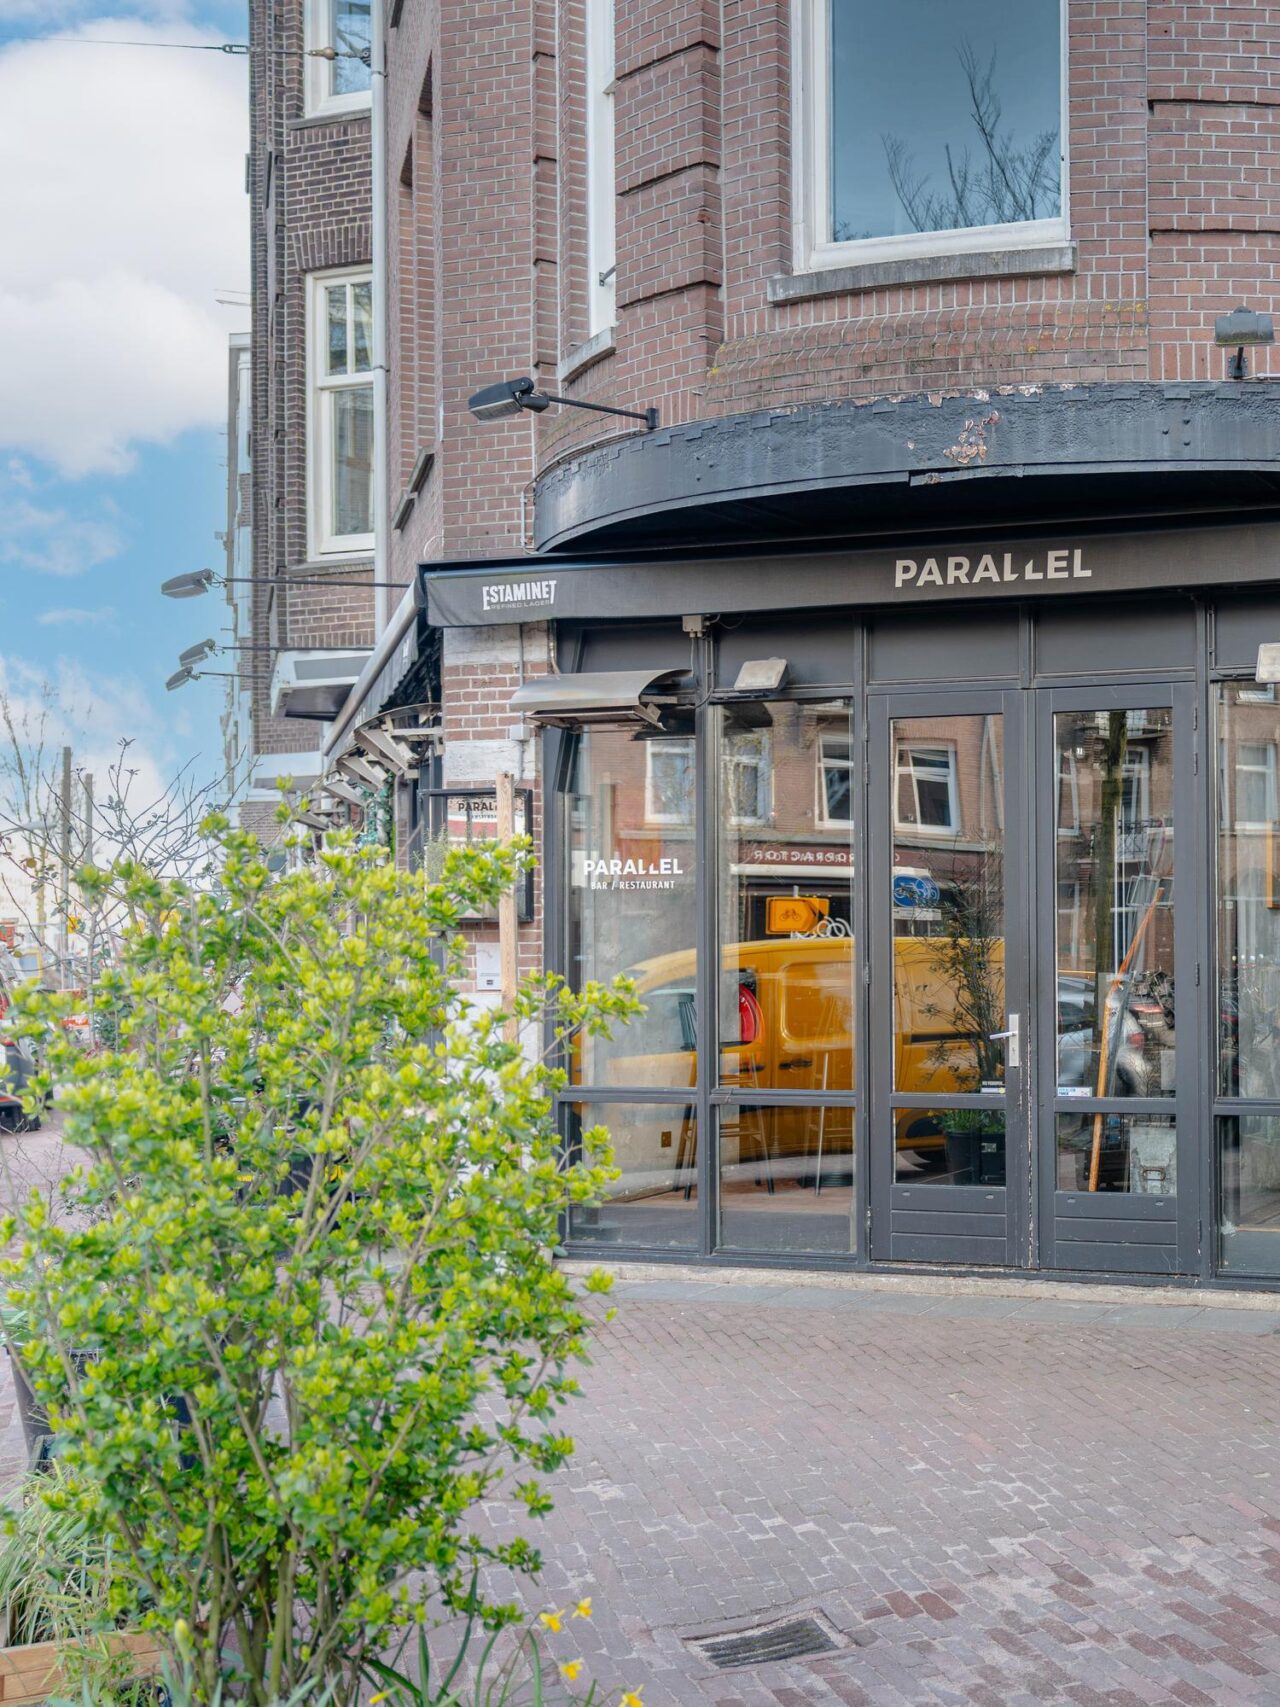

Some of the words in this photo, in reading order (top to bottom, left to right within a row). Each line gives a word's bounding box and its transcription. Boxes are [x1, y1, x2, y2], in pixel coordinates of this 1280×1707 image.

[895, 549, 1092, 588] PARALLEL
[482, 580, 557, 610] ESTAMINET
[458, 801, 498, 812] PARAL
[583, 858, 683, 876] PARALLEL
[591, 881, 608, 890] BAR
[619, 880, 675, 890] RESTAURANT
